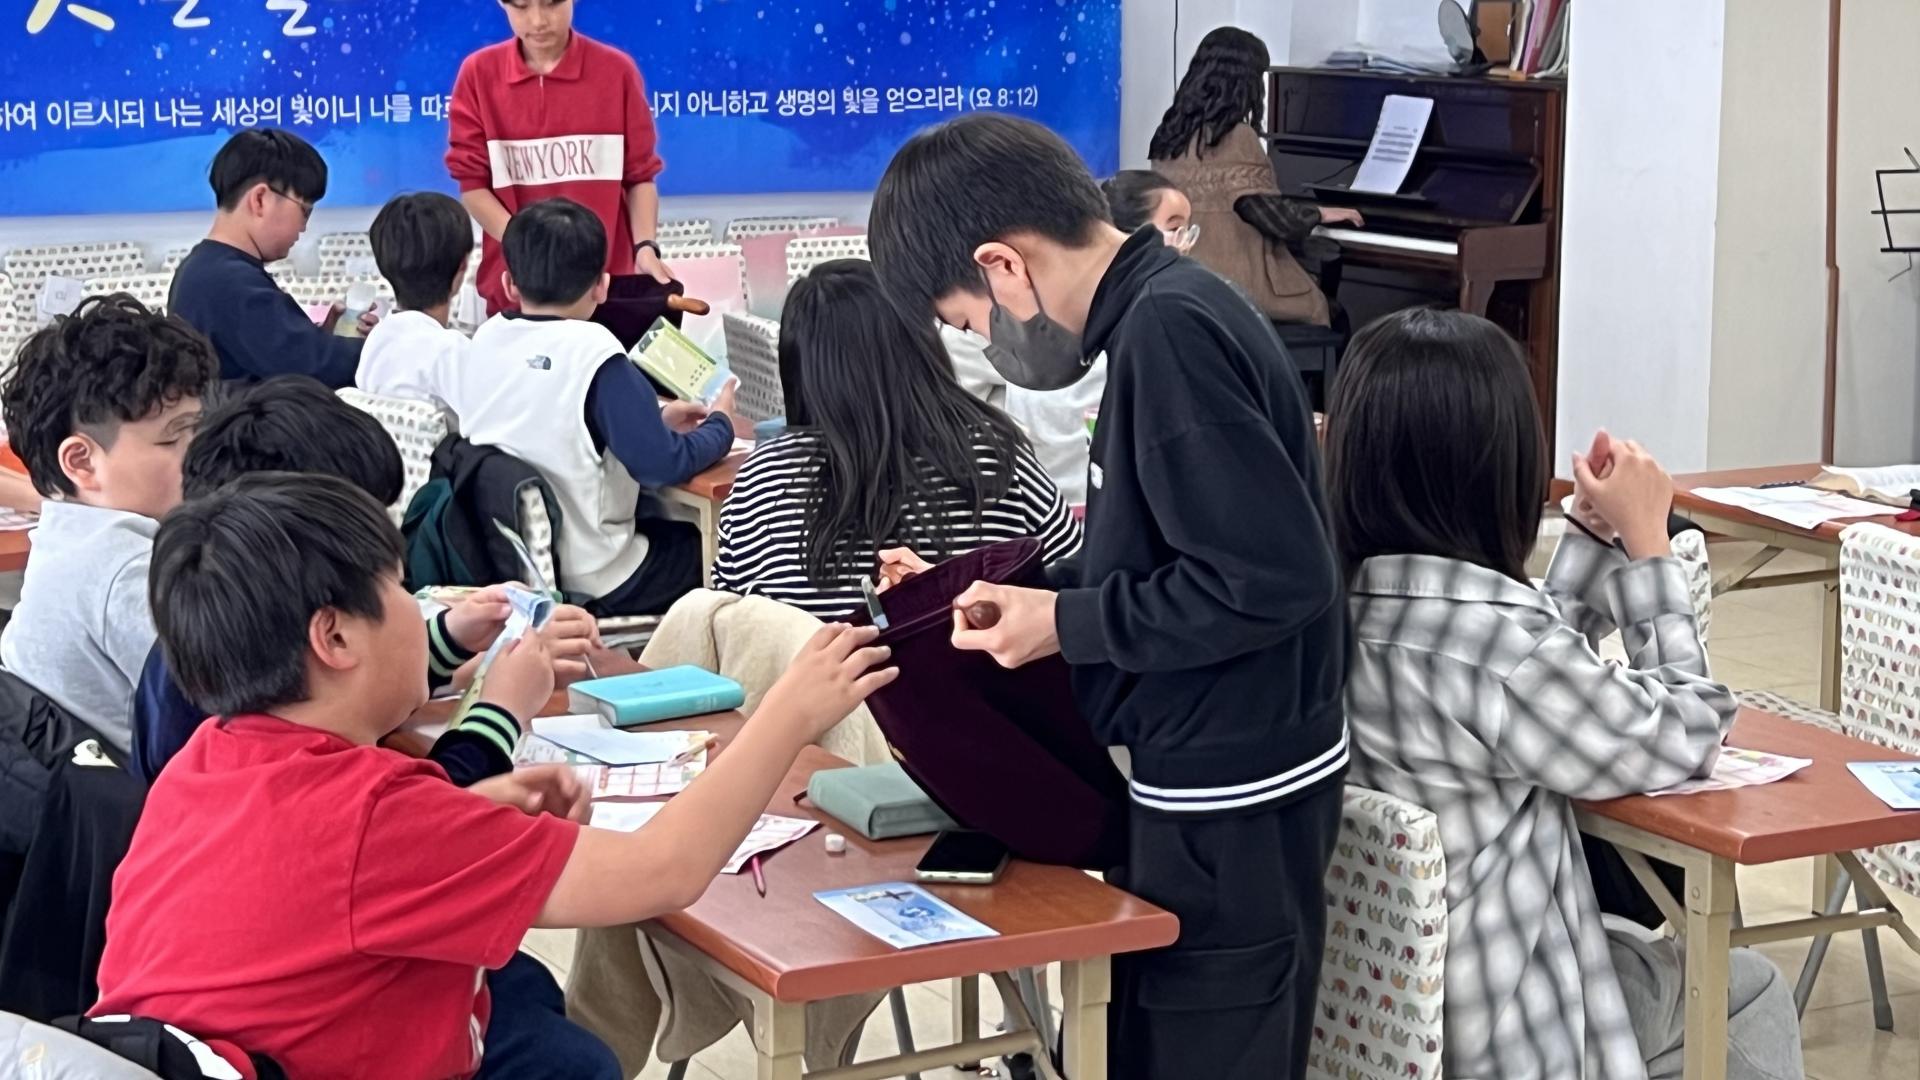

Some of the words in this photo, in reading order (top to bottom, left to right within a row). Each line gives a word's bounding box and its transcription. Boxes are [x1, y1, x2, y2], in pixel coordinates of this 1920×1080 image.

[46, 99, 145, 130] 이르시되
[154, 98, 203, 128] 나는
[211, 96, 282, 126] 세상의
[290, 94, 361, 125] 빛이니
[369, 94, 412, 123] 나를
[687, 89, 769, 118] 아니하고
[775, 89, 836, 117] 생명의
[842, 86, 880, 115] 빛을
[886, 85, 964, 113] 얻으리라
[969, 86, 993, 111] (요
[997, 85, 1039, 108] 8:12)
